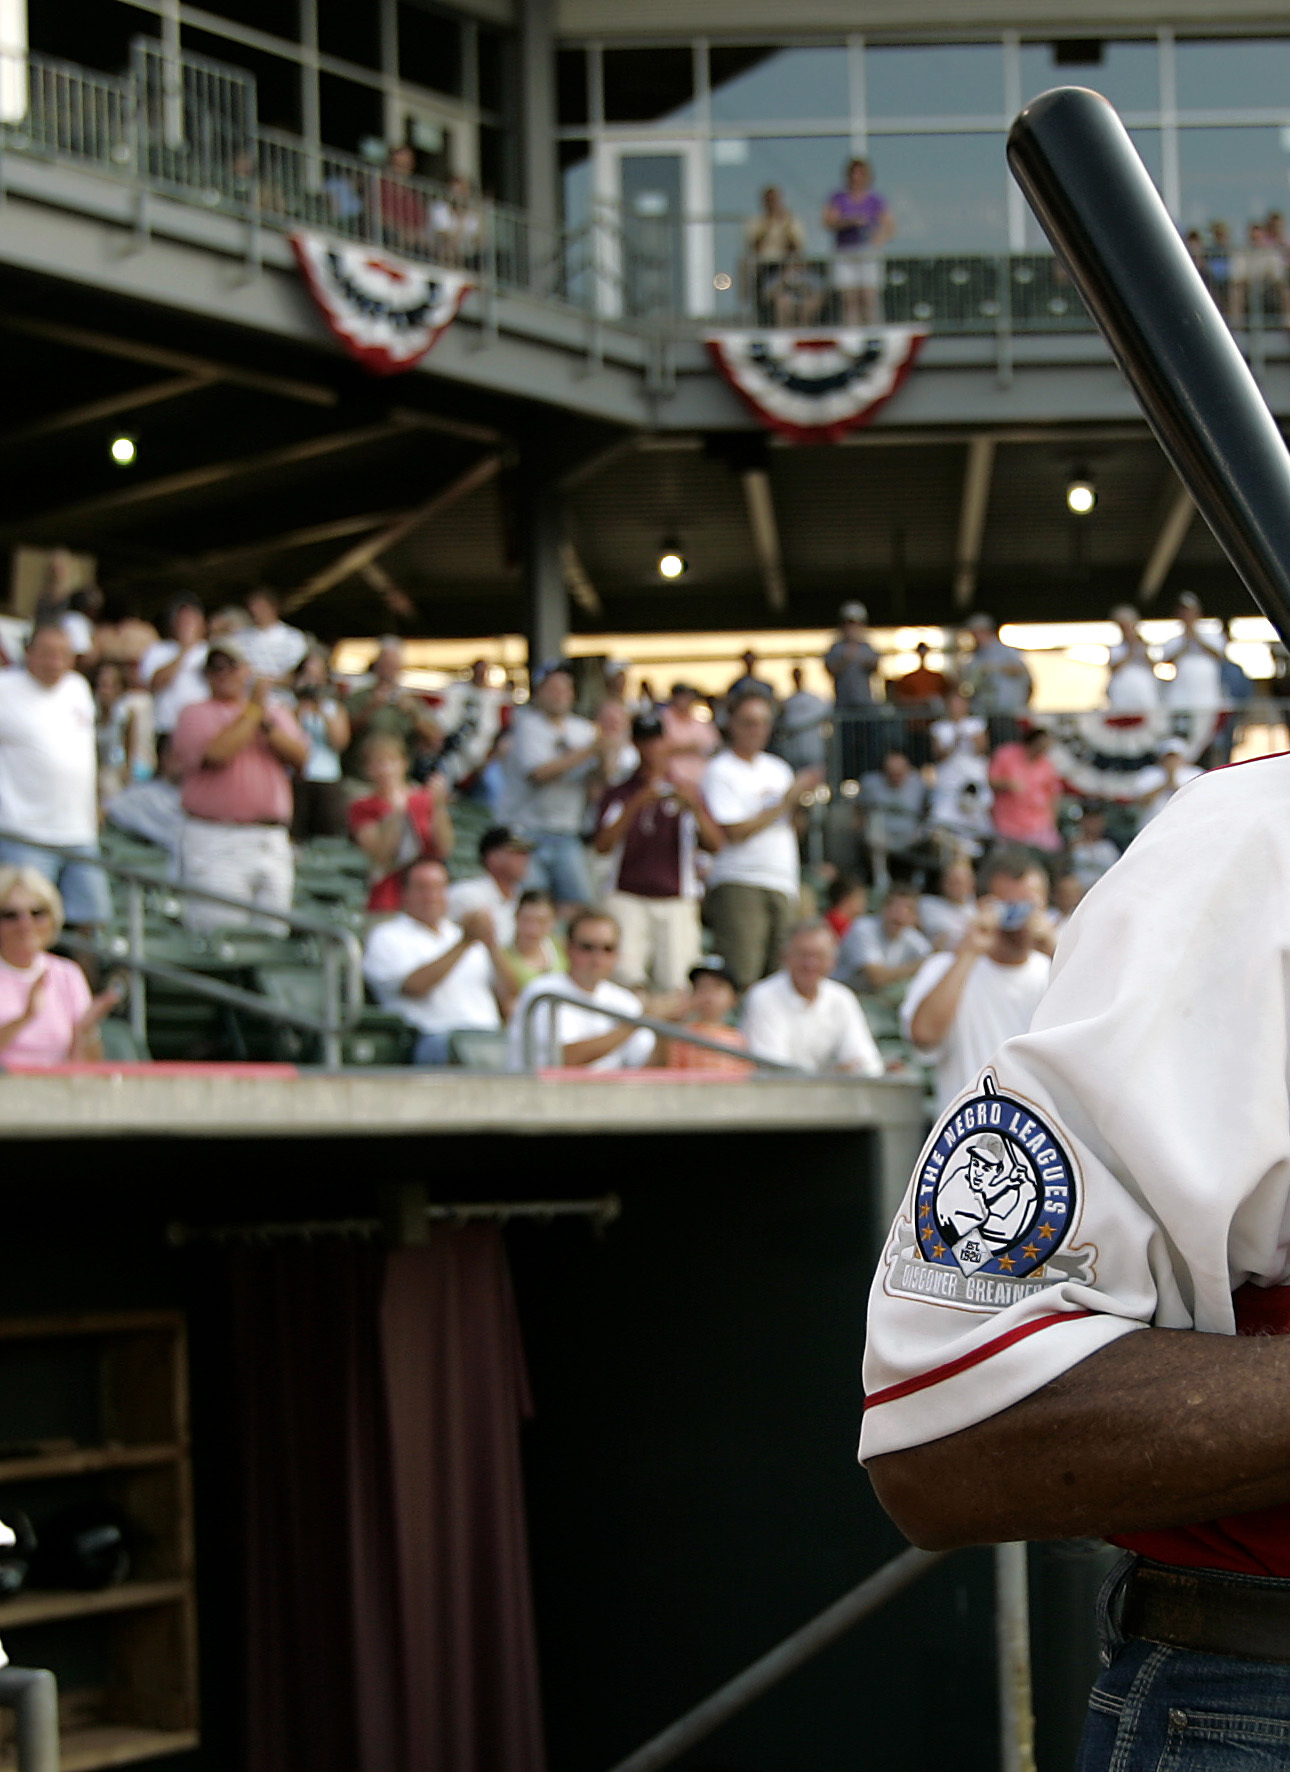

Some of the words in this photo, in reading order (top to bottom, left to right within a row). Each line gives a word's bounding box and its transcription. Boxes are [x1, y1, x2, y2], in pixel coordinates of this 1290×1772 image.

[920, 1152, 945, 1196] THE
[945, 1103, 1001, 1148] NEGRO
[1008, 1111, 1069, 1216] LEAGUES
[902, 1264, 958, 1297] DISCOVER
[966, 1277, 1051, 1304] GREATNE
